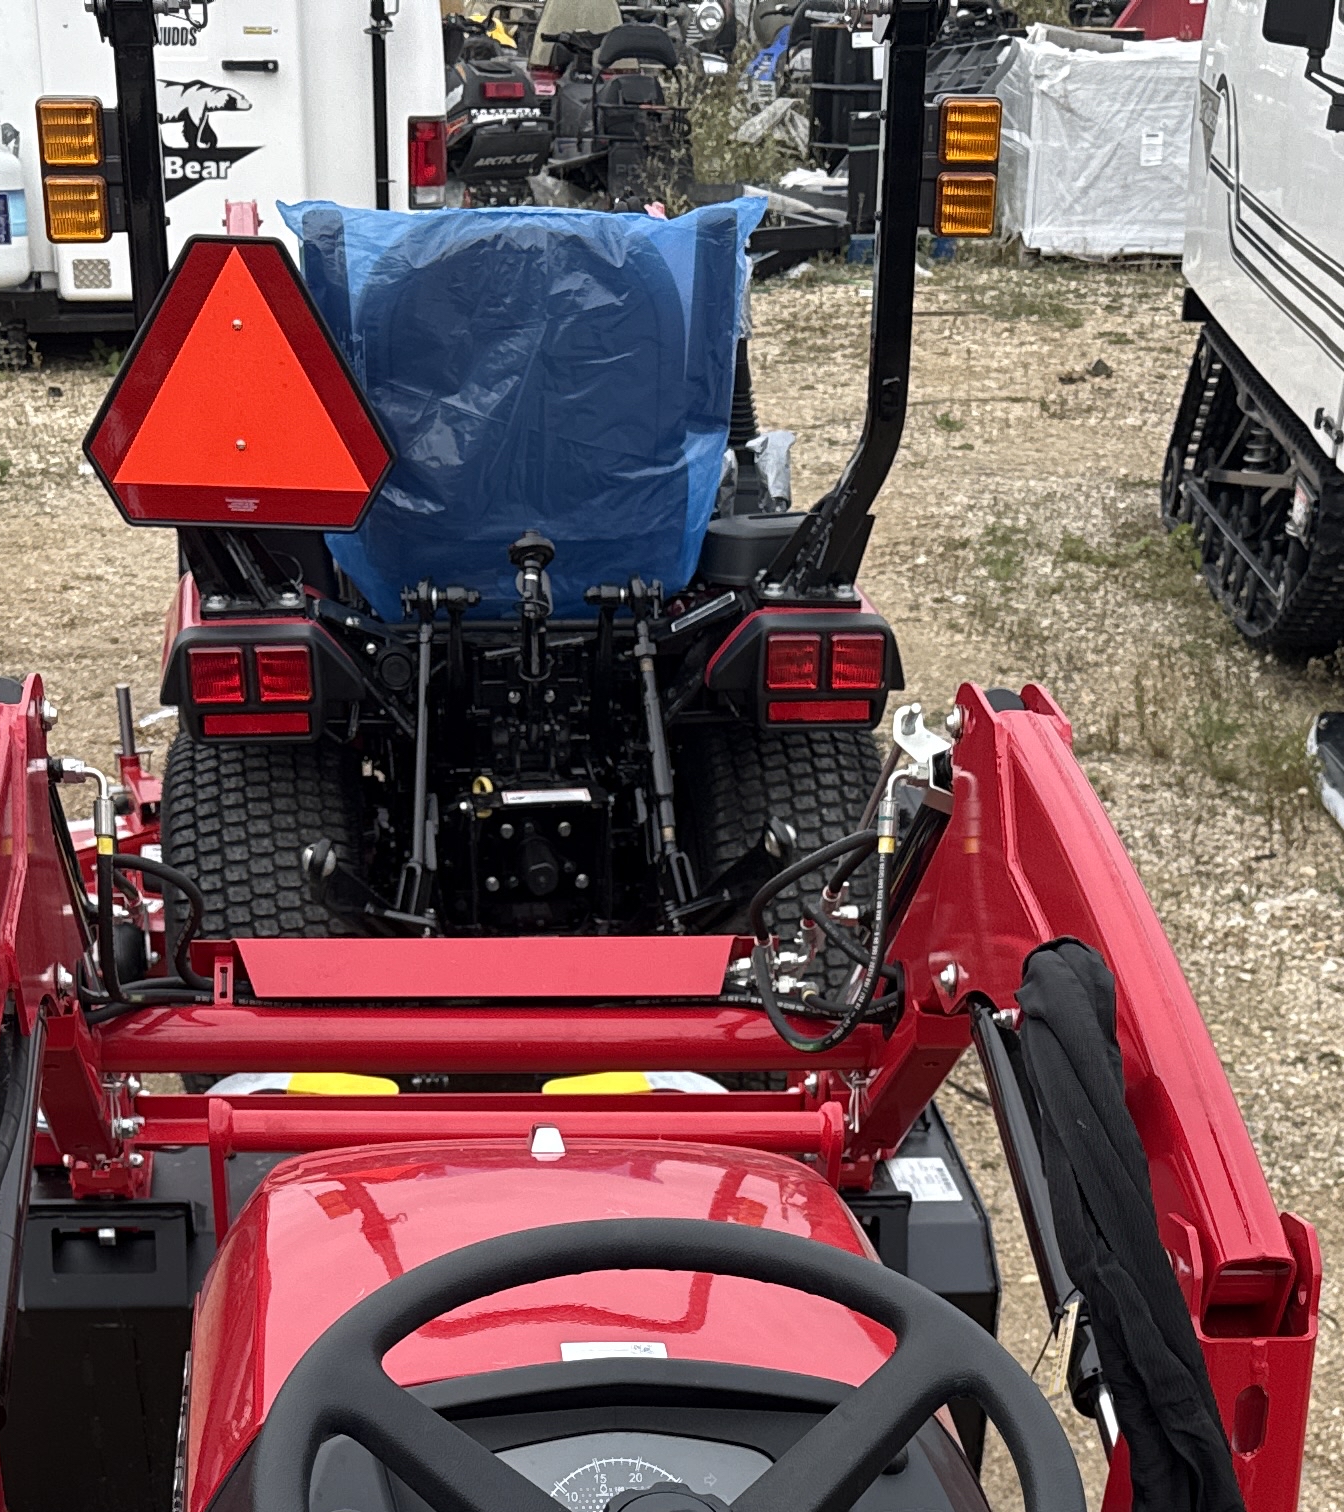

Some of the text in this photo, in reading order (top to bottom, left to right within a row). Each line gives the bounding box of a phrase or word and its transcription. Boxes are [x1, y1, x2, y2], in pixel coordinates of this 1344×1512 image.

[474, 153, 538, 167] ARCTIC CAT
[164, 156, 231, 179] Bear
[593, 1473, 643, 1484] 15 20
[564, 1491, 579, 1503] 10
